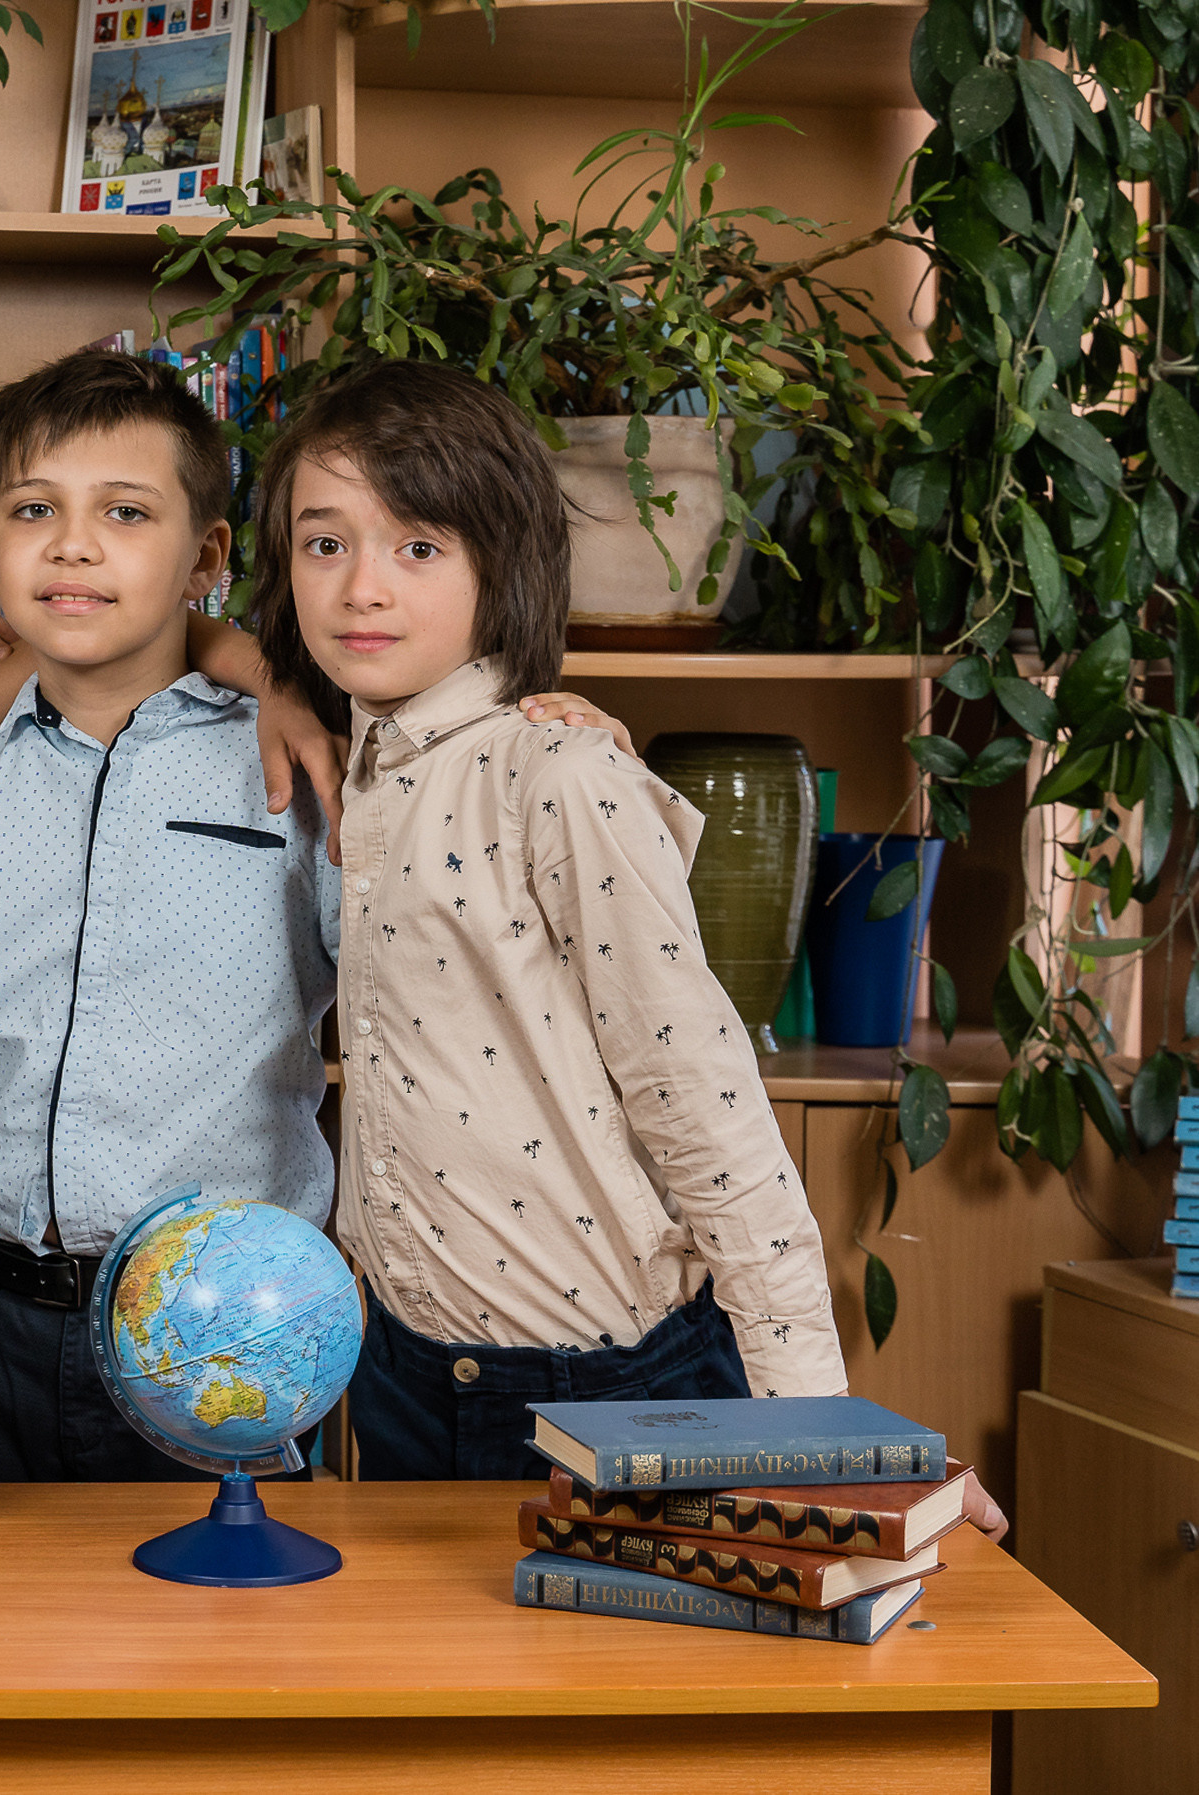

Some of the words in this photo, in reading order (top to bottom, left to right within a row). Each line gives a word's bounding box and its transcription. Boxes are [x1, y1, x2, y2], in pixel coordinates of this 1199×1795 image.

[666, 1494, 709, 1509] КУПЕР
[666, 1506, 710, 1518] Фенимор
[666, 1514, 706, 1526] Джеймс
[621, 1535, 654, 1552] КУПЕР
